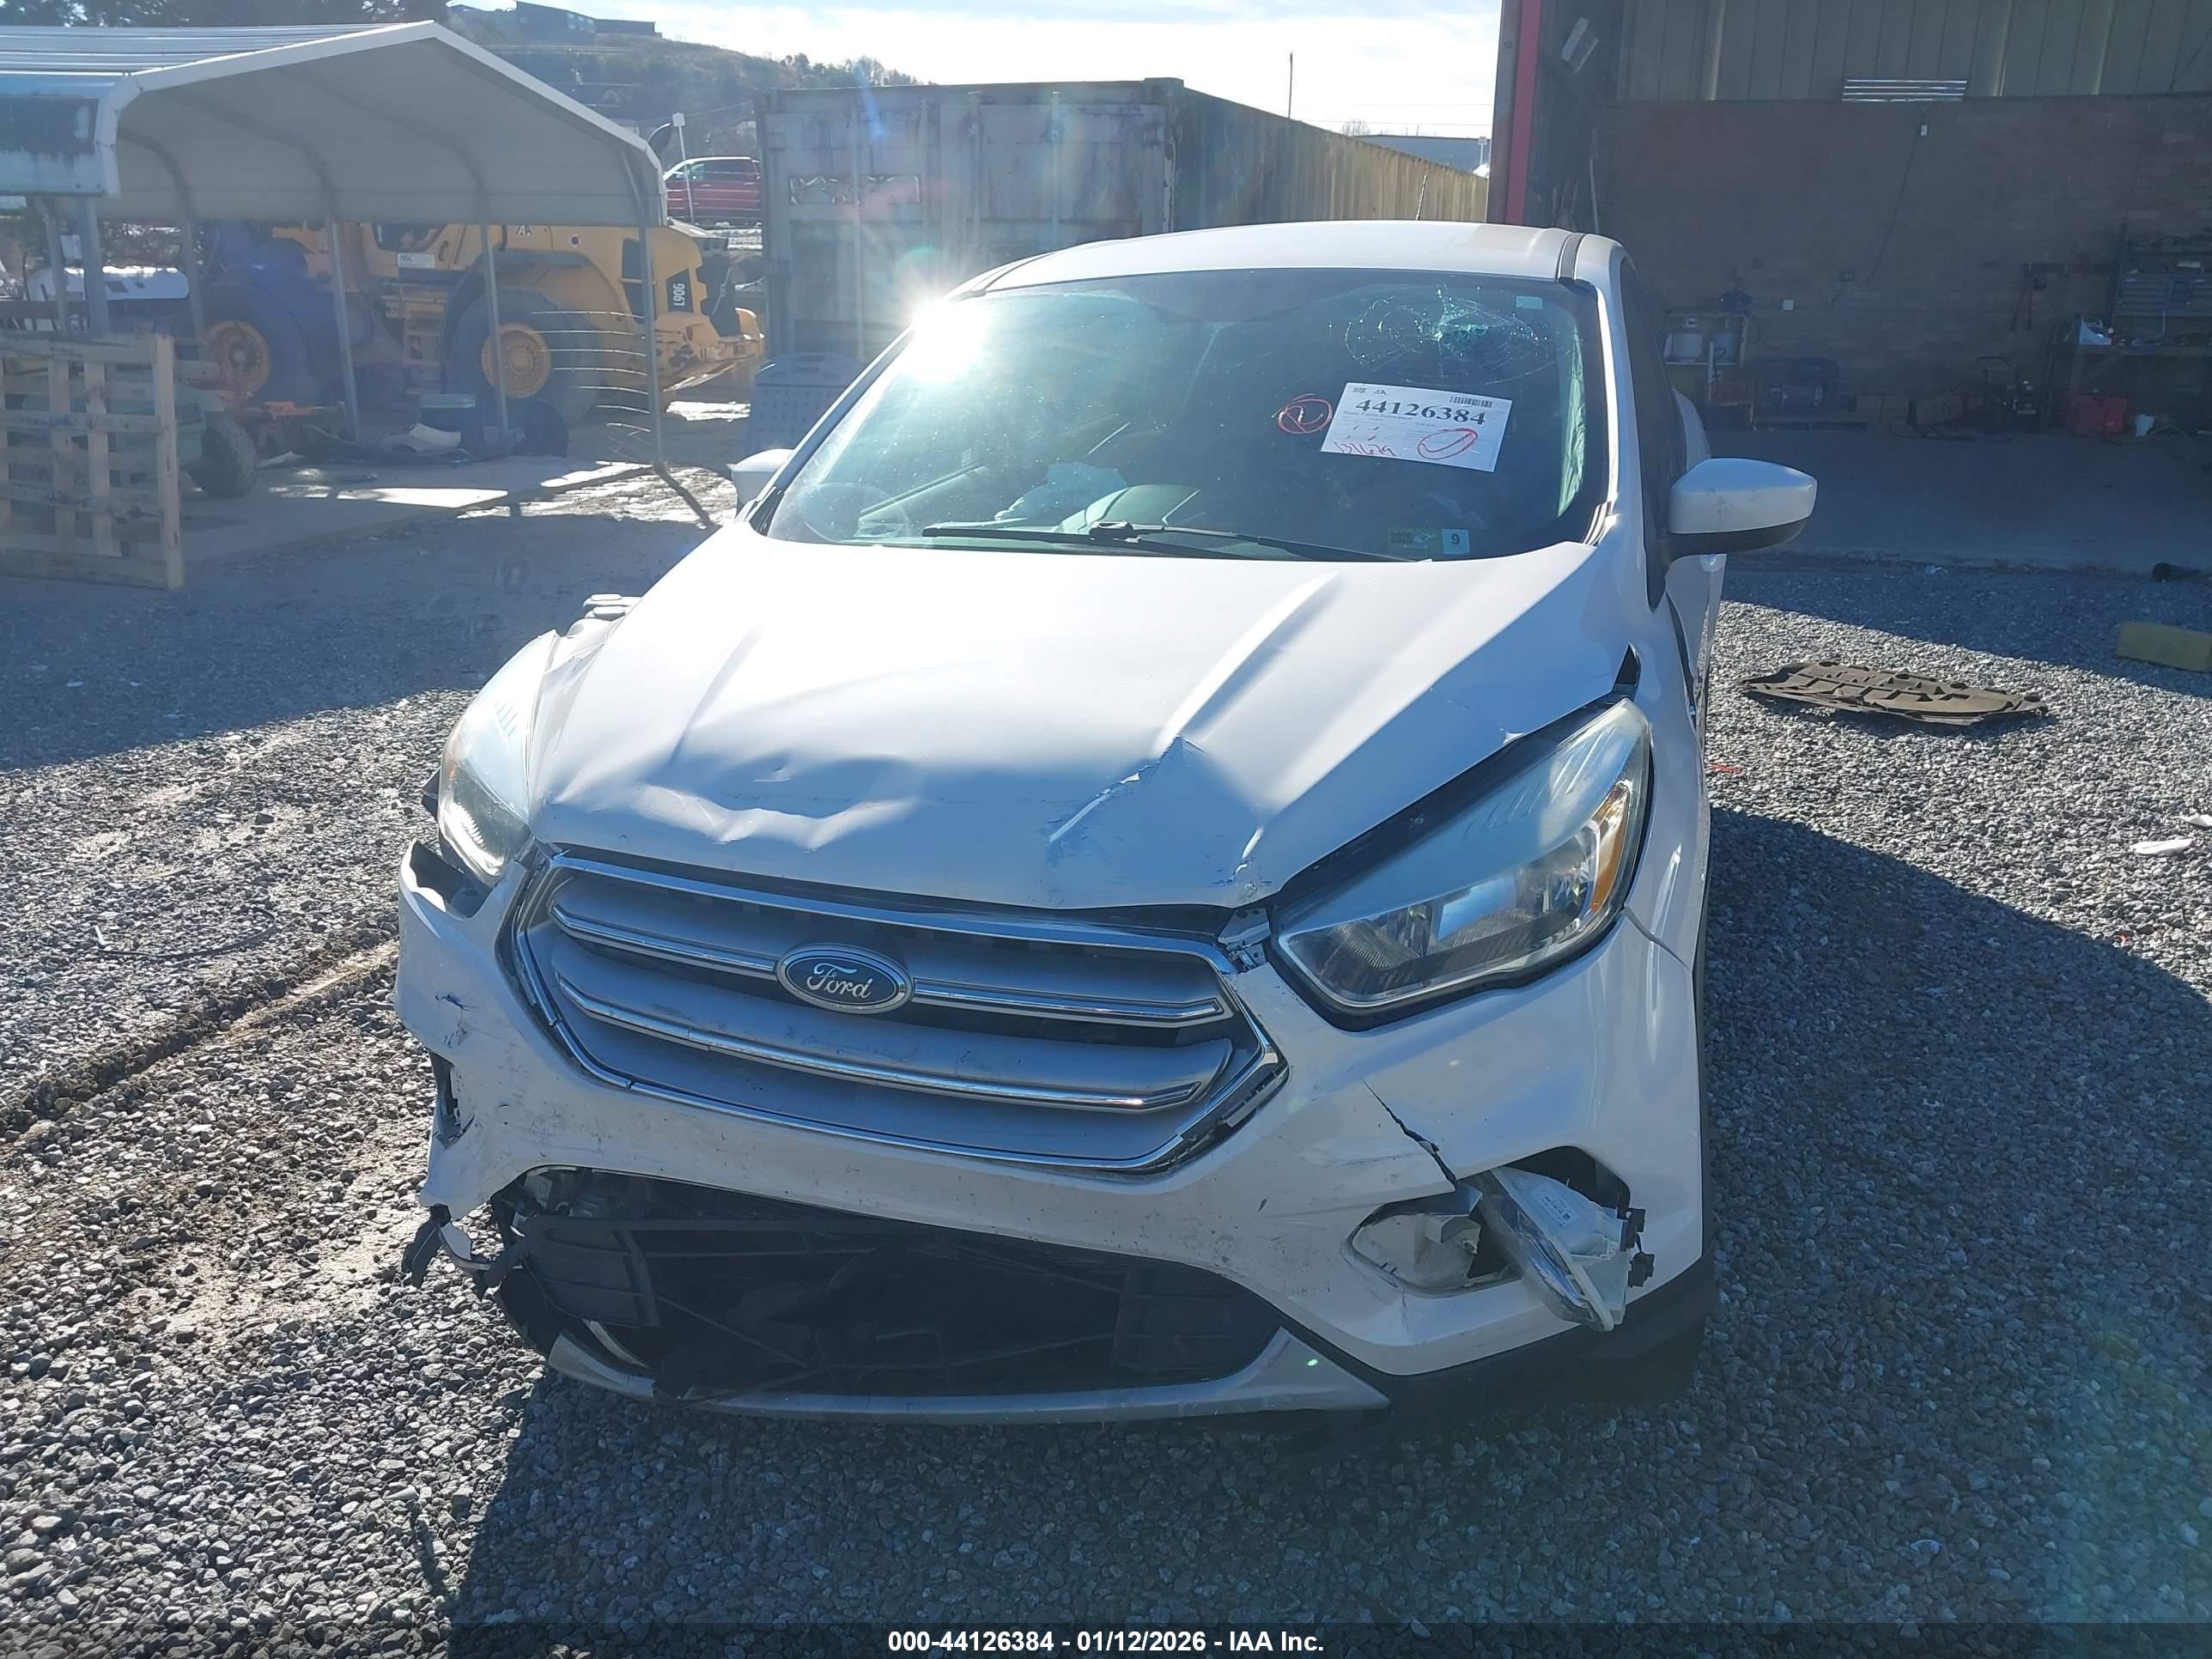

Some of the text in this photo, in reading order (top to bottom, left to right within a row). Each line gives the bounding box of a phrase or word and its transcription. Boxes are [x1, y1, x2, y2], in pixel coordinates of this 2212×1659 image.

[672, 283, 685, 307] L90G
[1355, 398, 1486, 425] 44126384
[1450, 533, 1460, 545] 9
[806, 963, 873, 999] Ford
